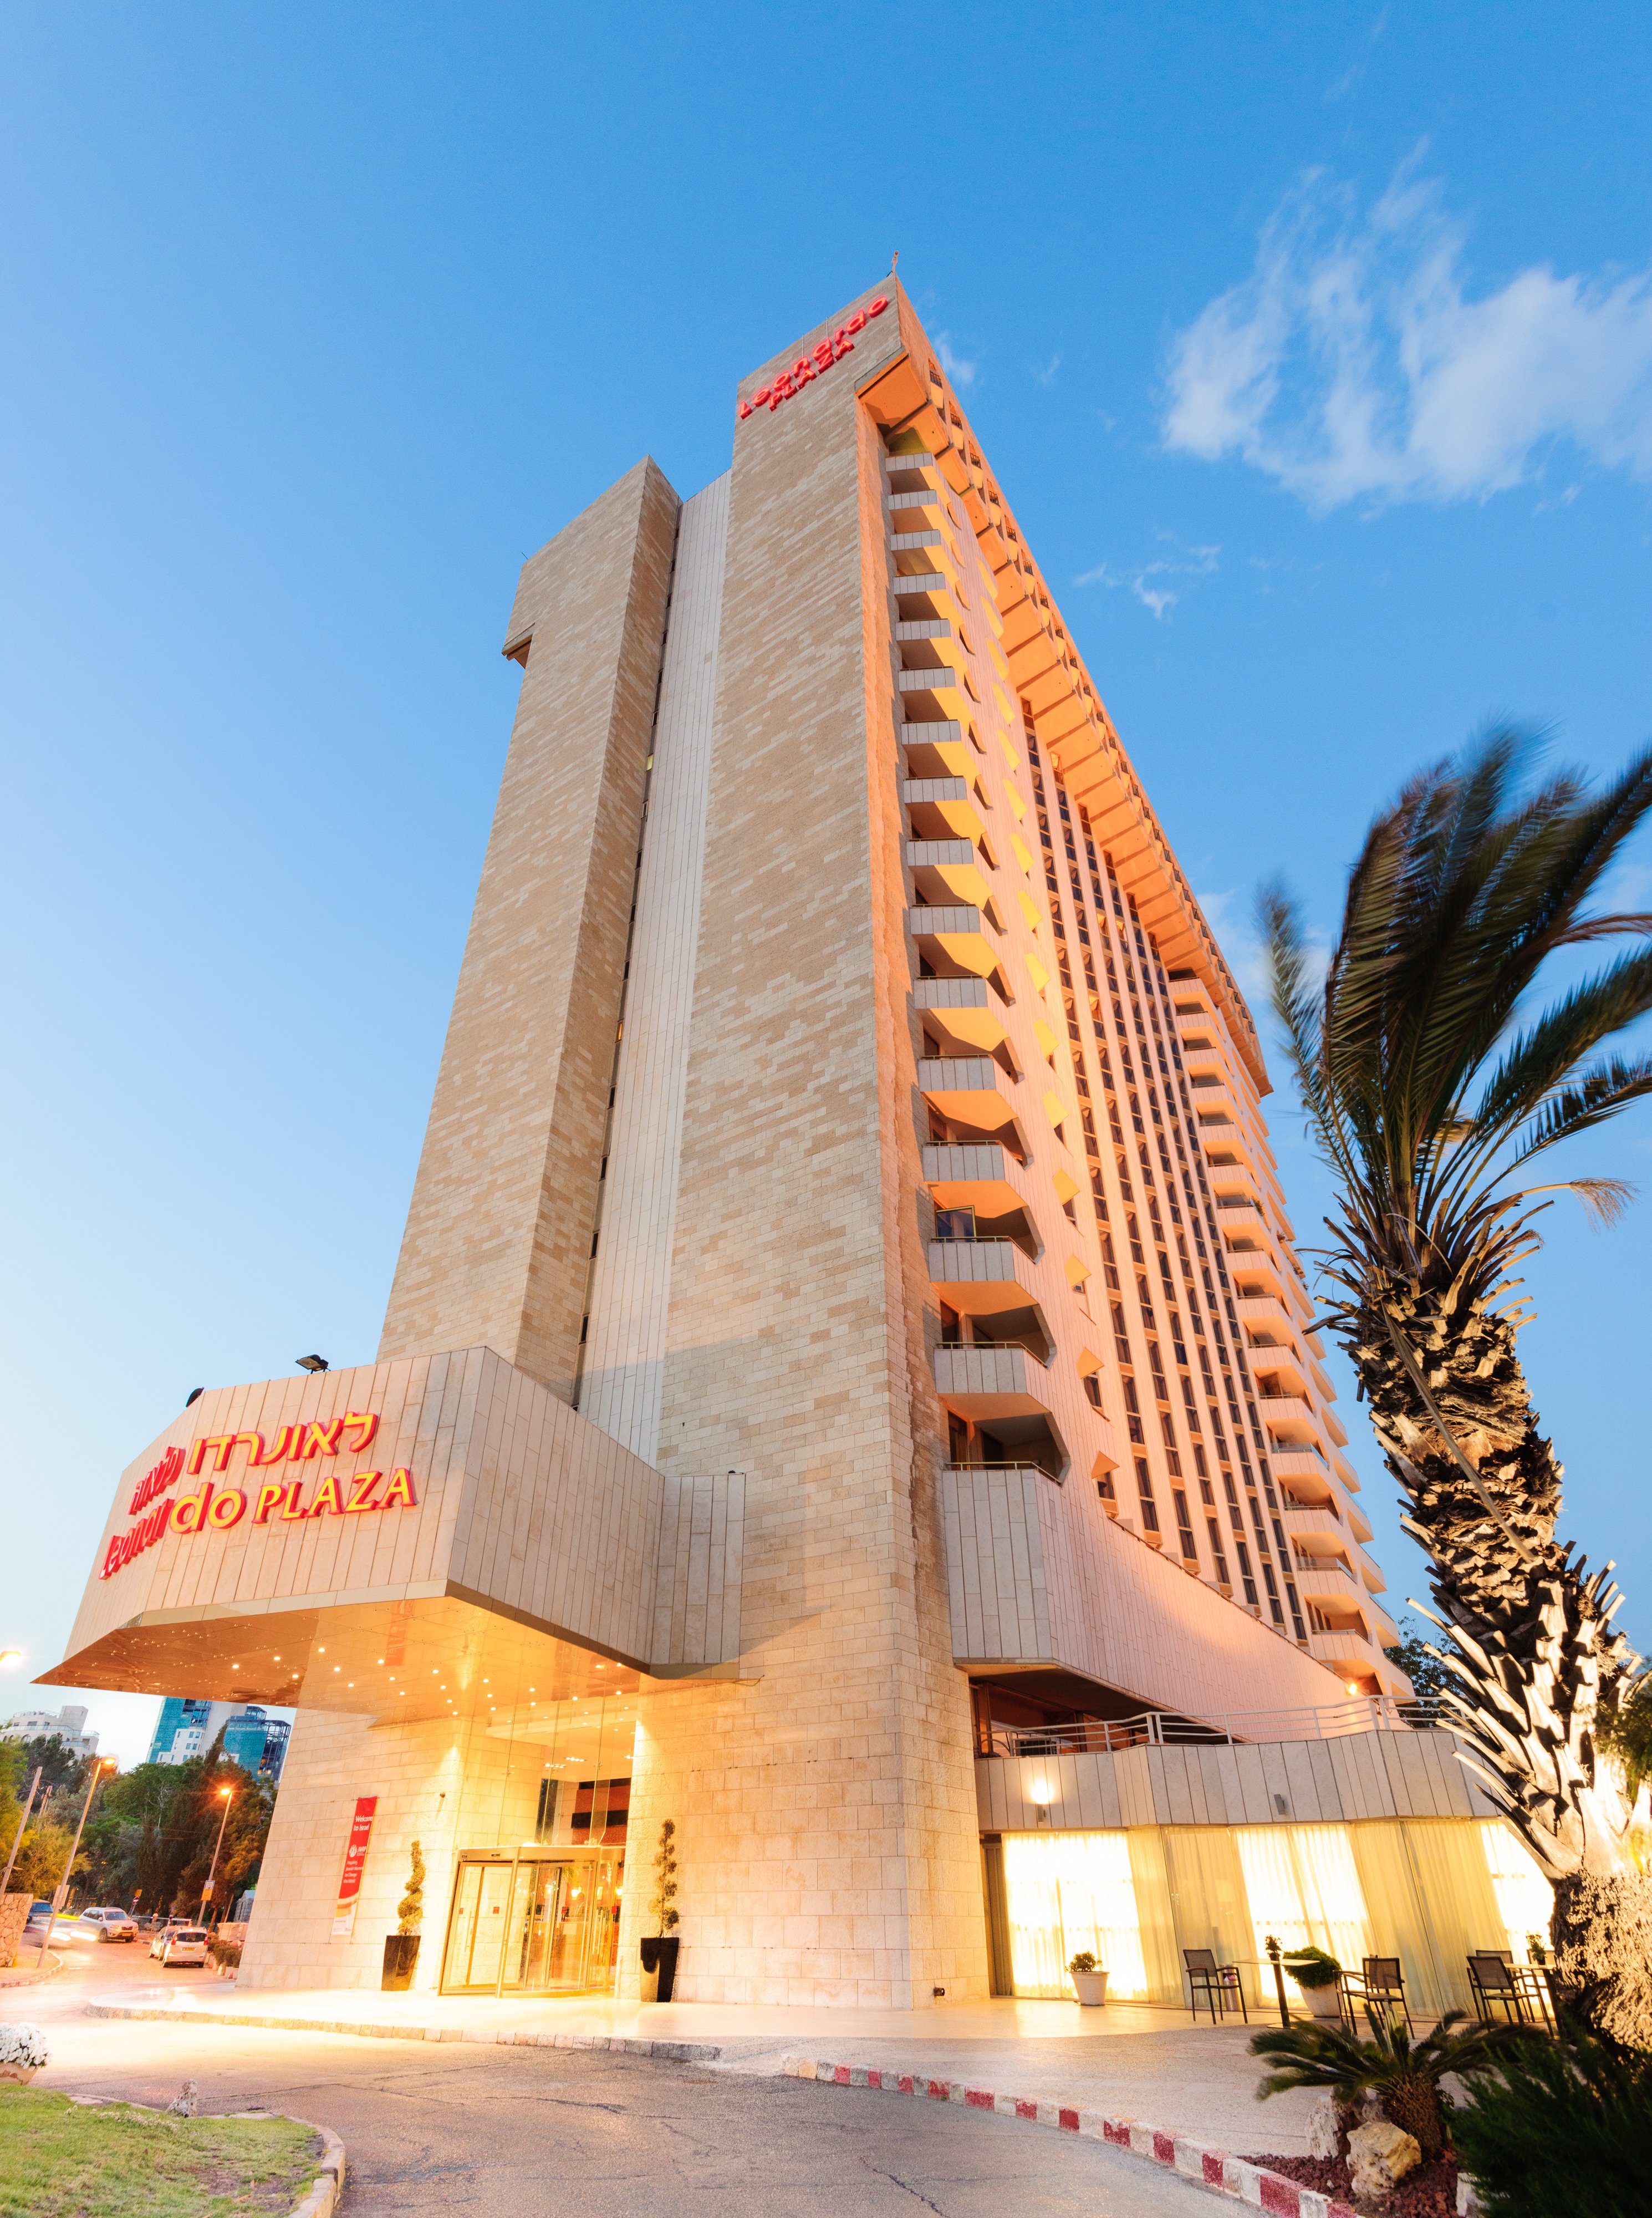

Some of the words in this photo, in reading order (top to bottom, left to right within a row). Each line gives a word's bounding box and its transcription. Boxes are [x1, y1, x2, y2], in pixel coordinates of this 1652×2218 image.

[739, 295, 888, 420] Leonardo
[769, 338, 855, 411] PLAZA
[187, 1411, 379, 1475] לאונרדו
[251, 1467, 420, 1524] PLAZA
